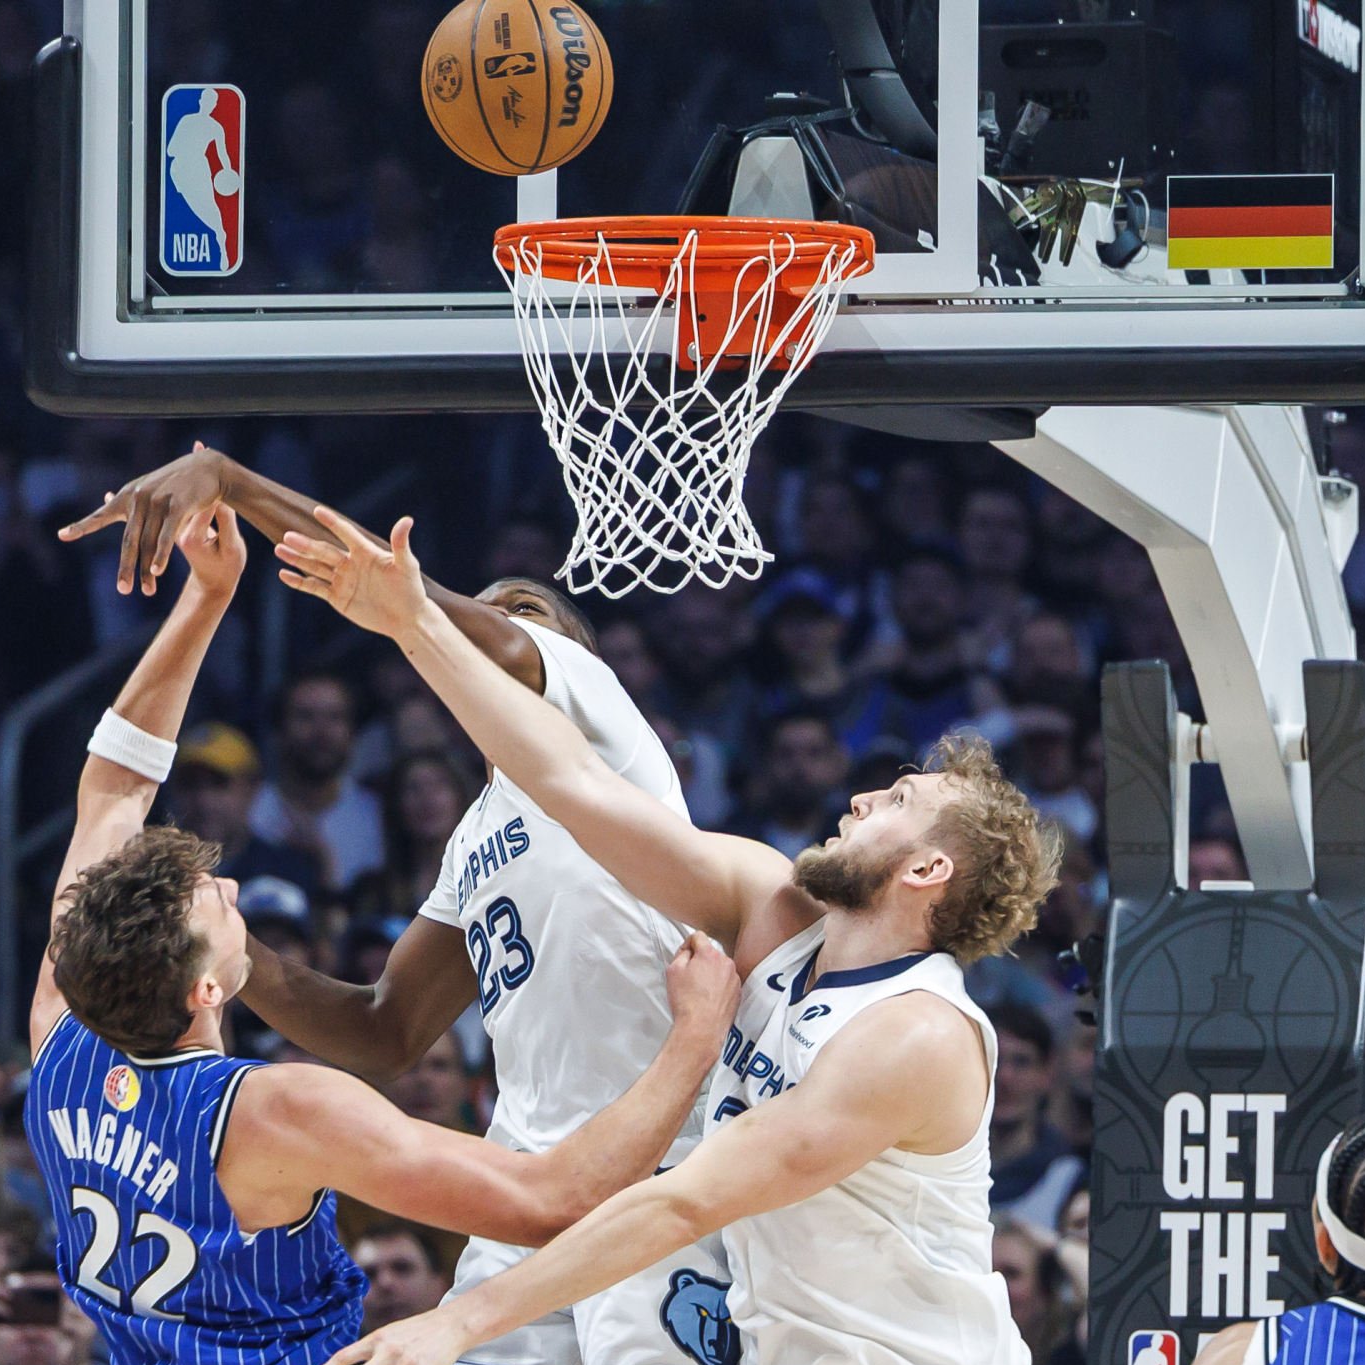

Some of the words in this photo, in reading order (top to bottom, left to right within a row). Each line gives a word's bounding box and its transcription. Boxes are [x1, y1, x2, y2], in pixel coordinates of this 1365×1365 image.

[549, 6, 591, 128] Wilson
[173, 233, 211, 263] NBA
[468, 895, 536, 1019] 23
[47, 1108, 179, 1205] WAGNER
[1162, 1090, 1287, 1200] GET
[70, 1184, 198, 1322] 22
[1159, 1211, 1287, 1318] THE
